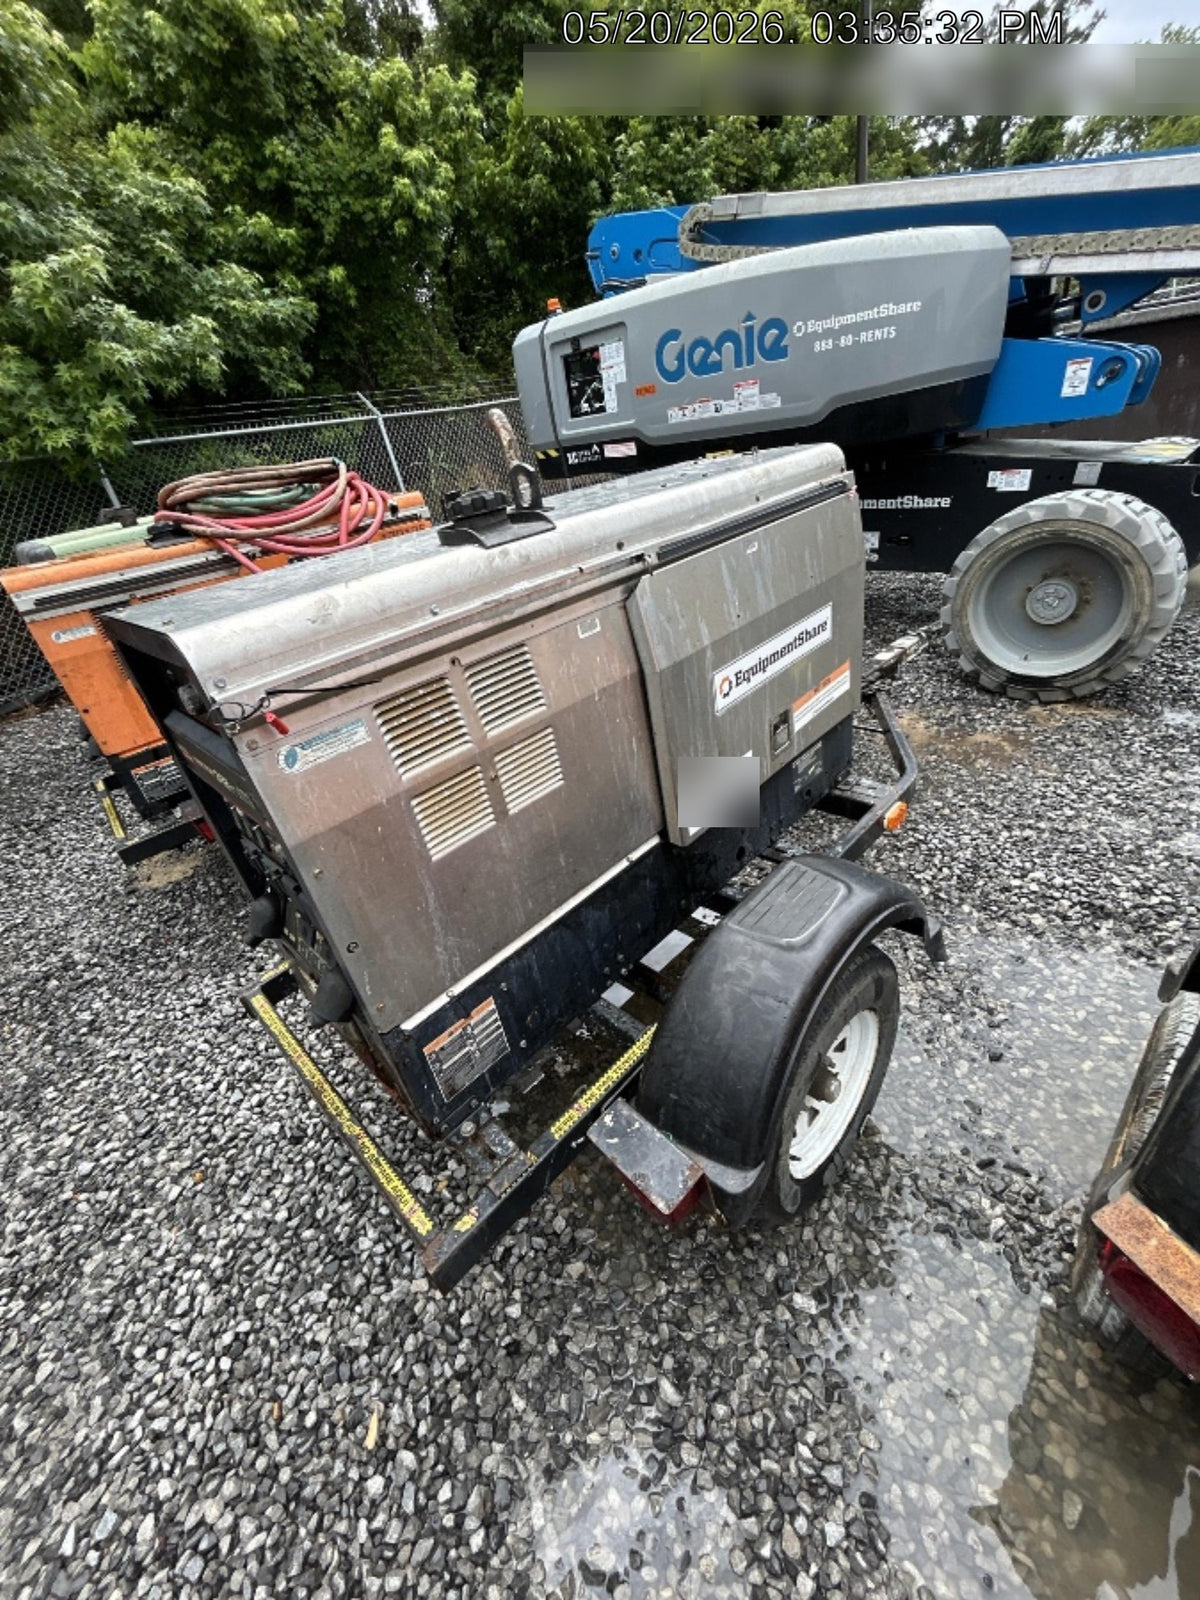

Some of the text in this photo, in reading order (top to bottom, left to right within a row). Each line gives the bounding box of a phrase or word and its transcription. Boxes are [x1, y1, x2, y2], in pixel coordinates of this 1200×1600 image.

[807, 301, 922, 333] EquipmentShare
[655, 311, 790, 384] Genie
[860, 495, 952, 509] mentShare
[734, 620, 828, 688] EquipmentShare
